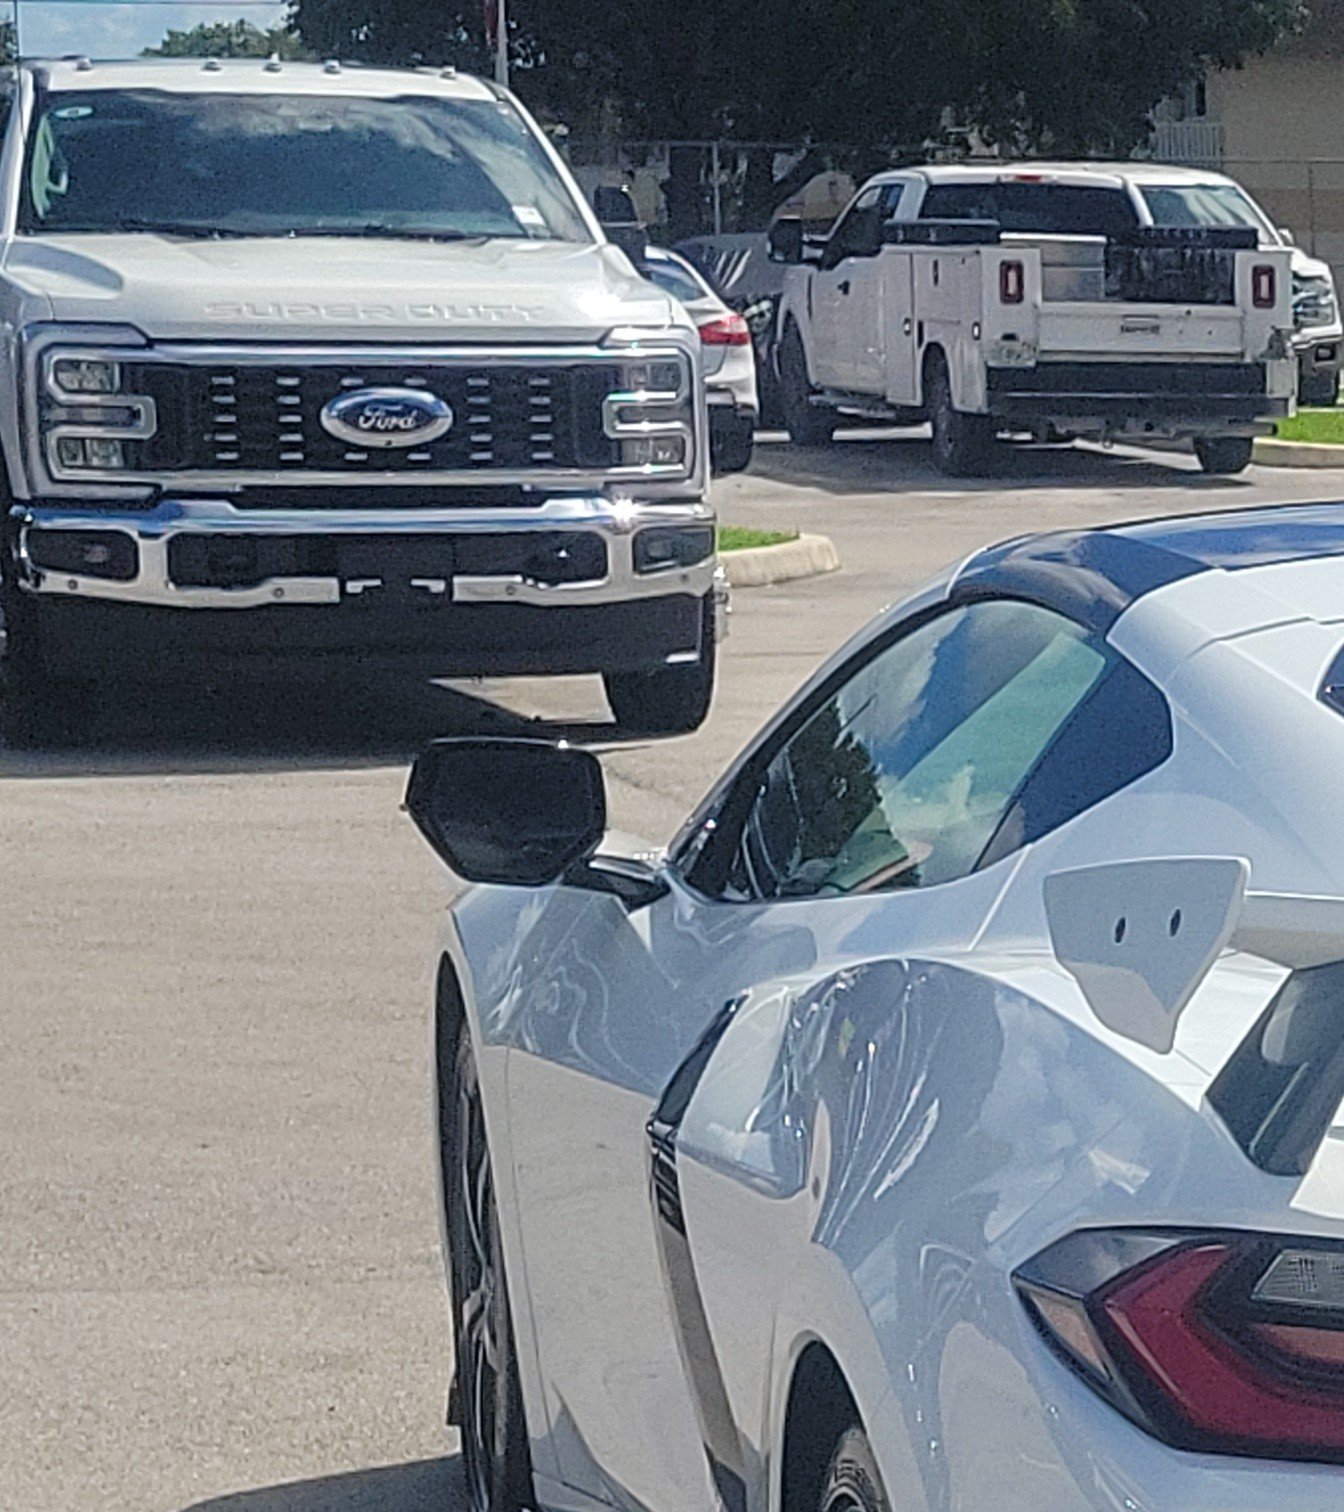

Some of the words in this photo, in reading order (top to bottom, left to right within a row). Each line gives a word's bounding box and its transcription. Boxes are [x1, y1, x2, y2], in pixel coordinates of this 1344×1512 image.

[203, 302, 397, 321] SUPER
[403, 302, 547, 322] DUTY
[357, 403, 419, 431] Ford
